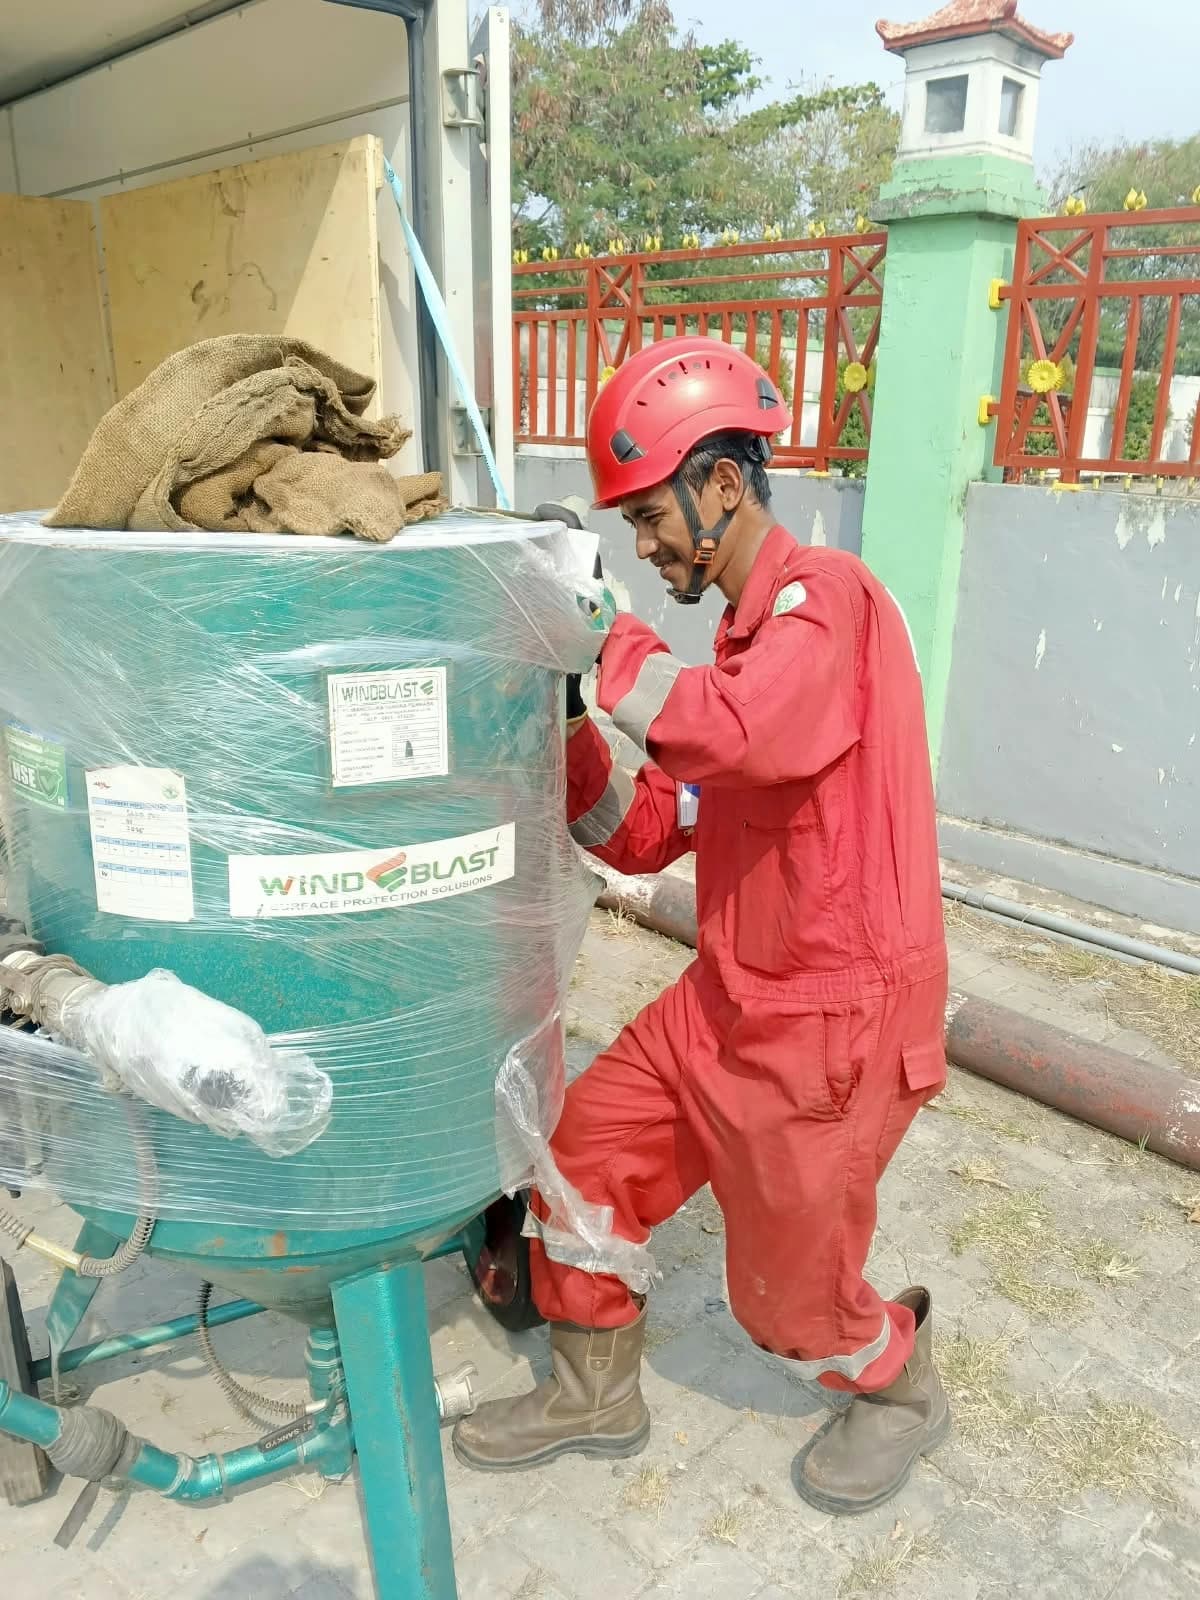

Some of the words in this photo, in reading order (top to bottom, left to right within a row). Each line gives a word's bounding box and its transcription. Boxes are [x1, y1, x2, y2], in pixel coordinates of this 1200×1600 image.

[341, 681, 418, 701] WINDBLAST
[12, 760, 37, 789] HSE
[410, 846, 499, 884] BLAST
[343, 889, 428, 906] PROTECTION
[432, 873, 493, 895] SOLUSIONS
[265, 1428, 300, 1449] SANKYO
